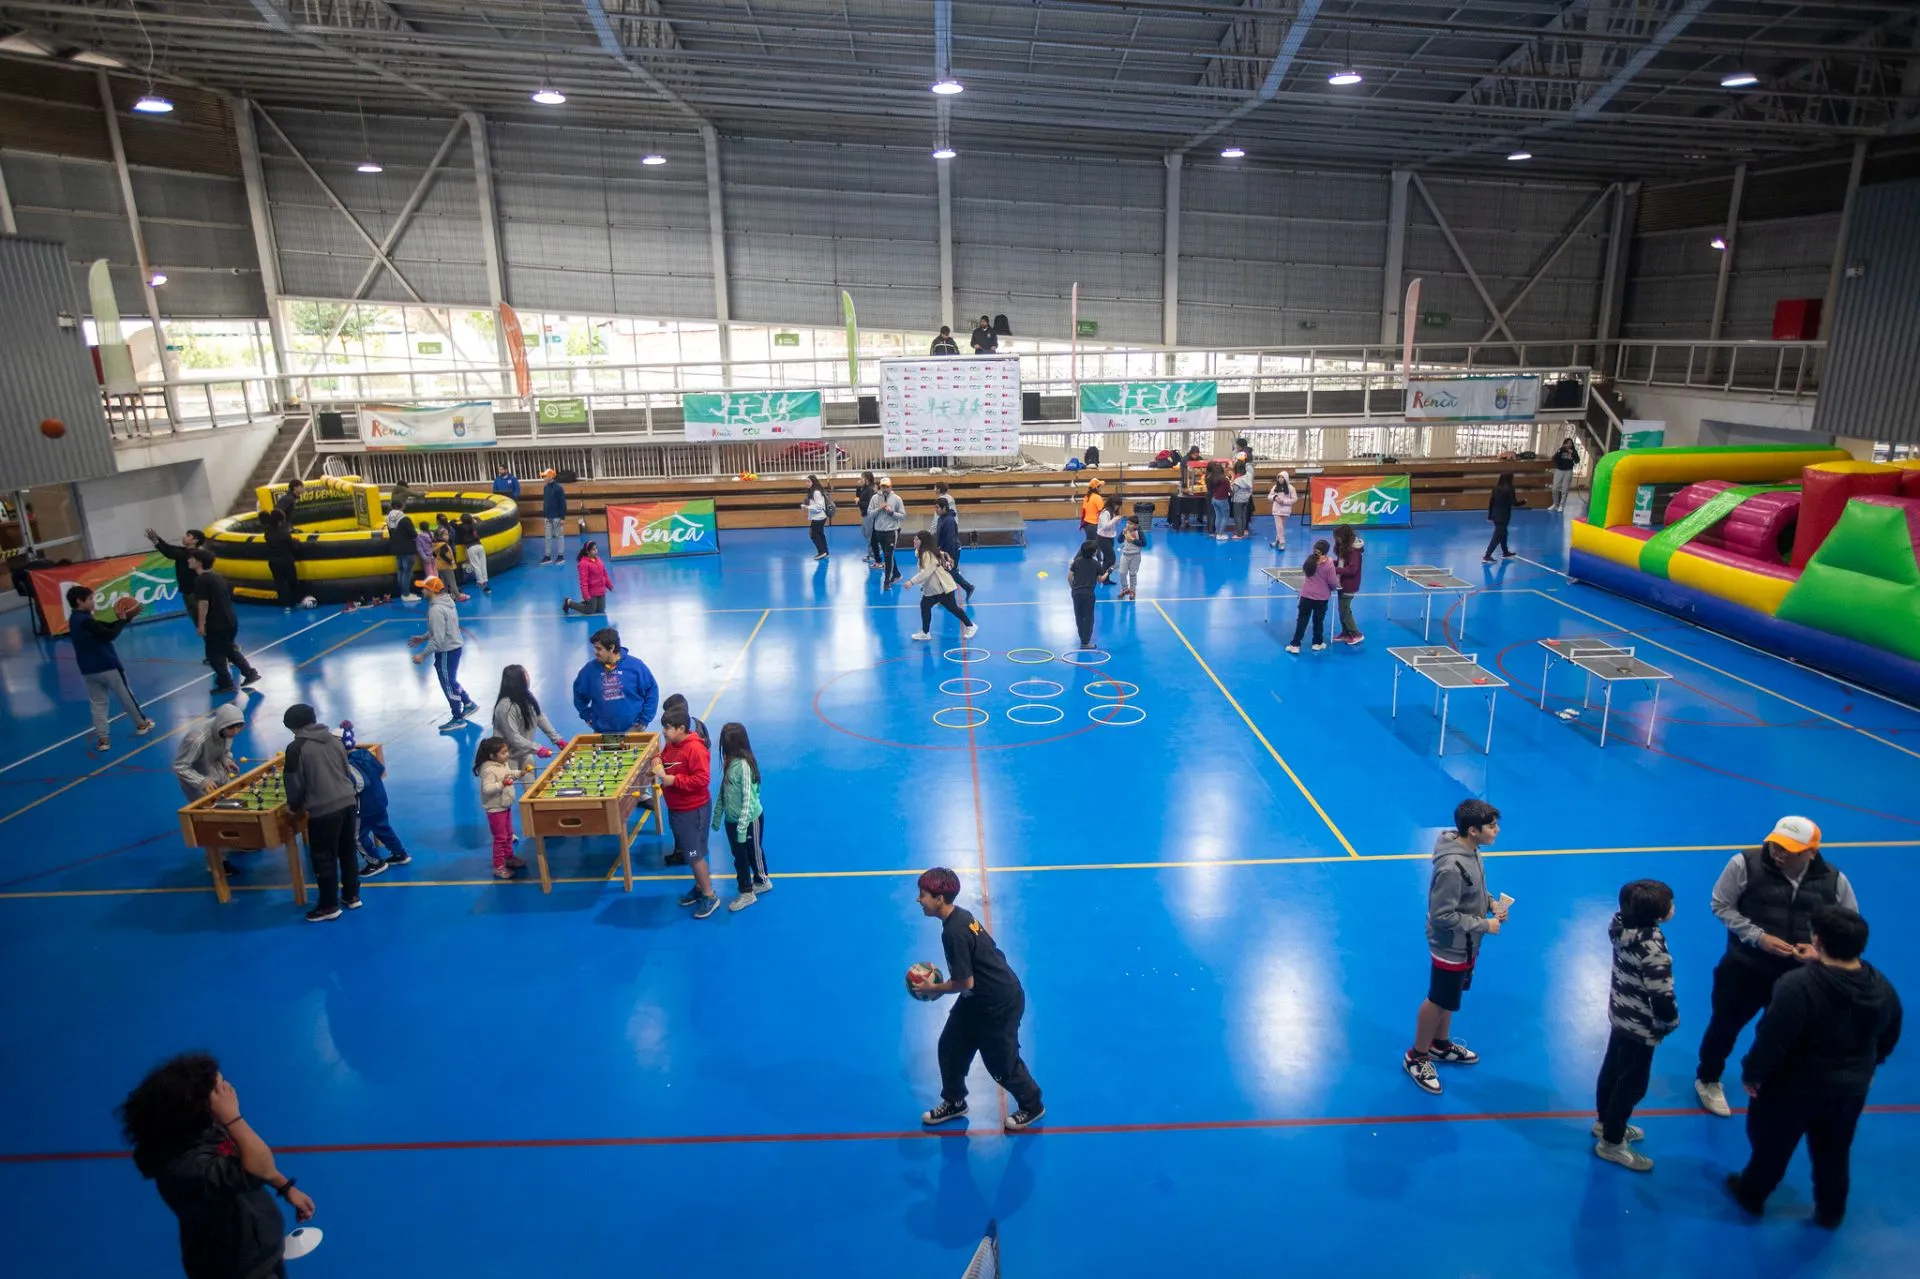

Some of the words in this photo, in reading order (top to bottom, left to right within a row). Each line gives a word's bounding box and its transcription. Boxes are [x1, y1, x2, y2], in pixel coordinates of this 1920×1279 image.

[1412, 390, 1459, 408] Renca
[742, 427, 761, 435] CCU
[1139, 418, 1157, 426] CCU
[1321, 487, 1399, 517] Renca
[621, 515, 705, 548] Renca
